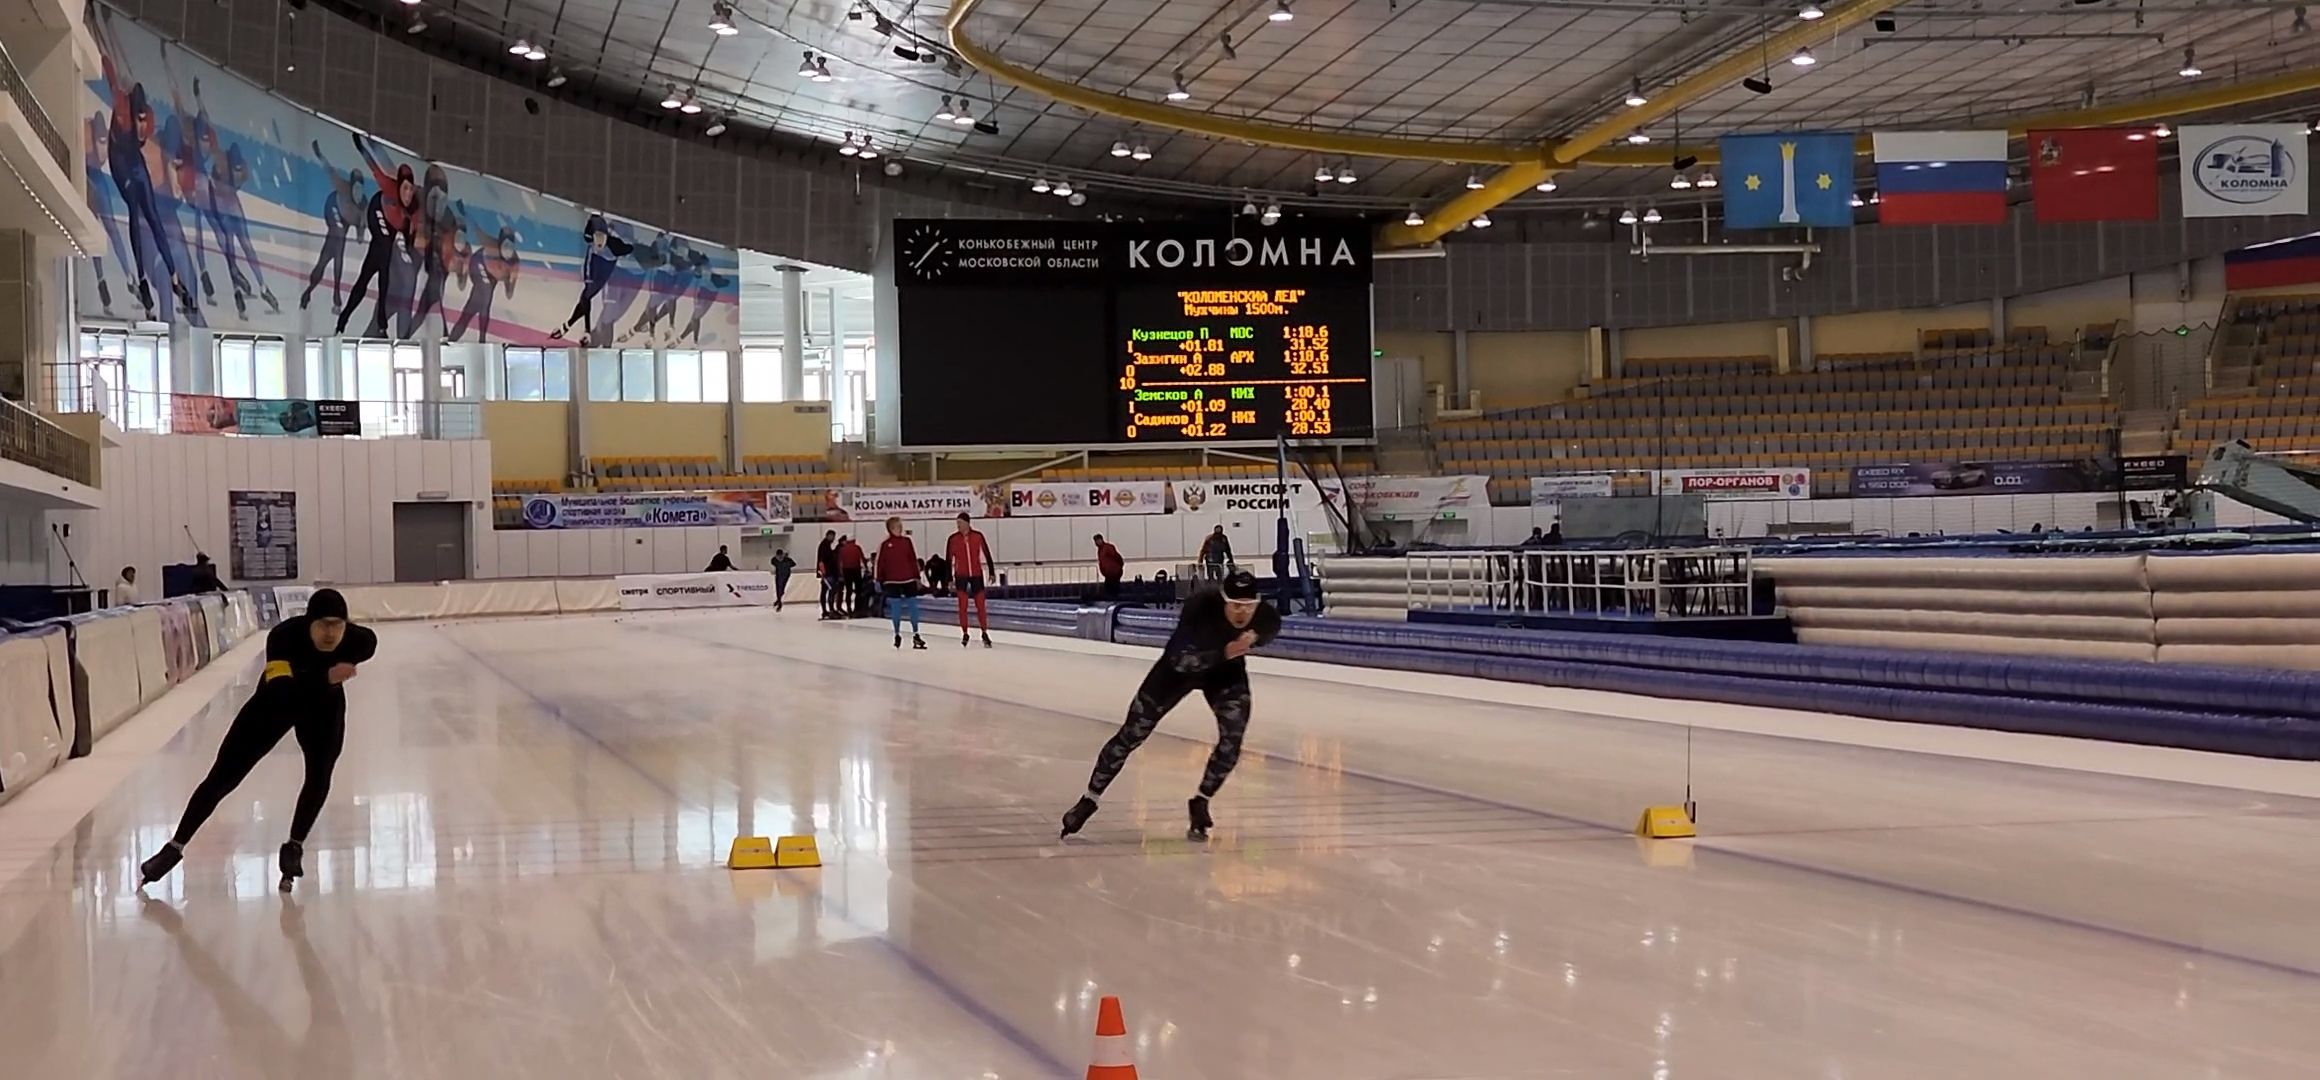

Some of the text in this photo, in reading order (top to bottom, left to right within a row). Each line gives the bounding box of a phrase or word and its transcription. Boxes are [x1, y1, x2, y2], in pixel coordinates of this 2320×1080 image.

[2221, 179, 2288, 188] КОЛОМНА
[958, 238, 1098, 251] КОНЬКОБЕЖНЫЙ ЦЕНТР
[1129, 237, 1356, 268] КОЛОМНА
[958, 256, 1099, 268] МОСКОВСКОЙ ОБЛАСТИ
[1132, 327, 1254, 341] Кузнецов П МОС
[1283, 325, 1329, 339] 1:18.6
[1290, 338, 1329, 350] 31.52
[1193, 352, 1203, 363] А
[1230, 350, 1255, 363] АРХ
[1284, 350, 1330, 363] 1:18.6
[1290, 362, 1329, 374] 32.51
[1119, 377, 1136, 390] 10
[1134, 388, 1188, 401] Земсков
[1194, 388, 1203, 400] А
[1285, 385, 1330, 398] 1:00.1
[1291, 398, 1331, 410] 28.40
[1134, 412, 1189, 426] Садиков
[1285, 409, 1331, 423] 1:00.1
[1291, 421, 1332, 434] 28.53
[855, 498, 971, 510] KOLOMNA TASTY FISH
[1226, 499, 1290, 509] РОССИИ
[645, 508, 707, 523] «Комета»
[656, 584, 716, 596] СПОРТИВНЫЙ
